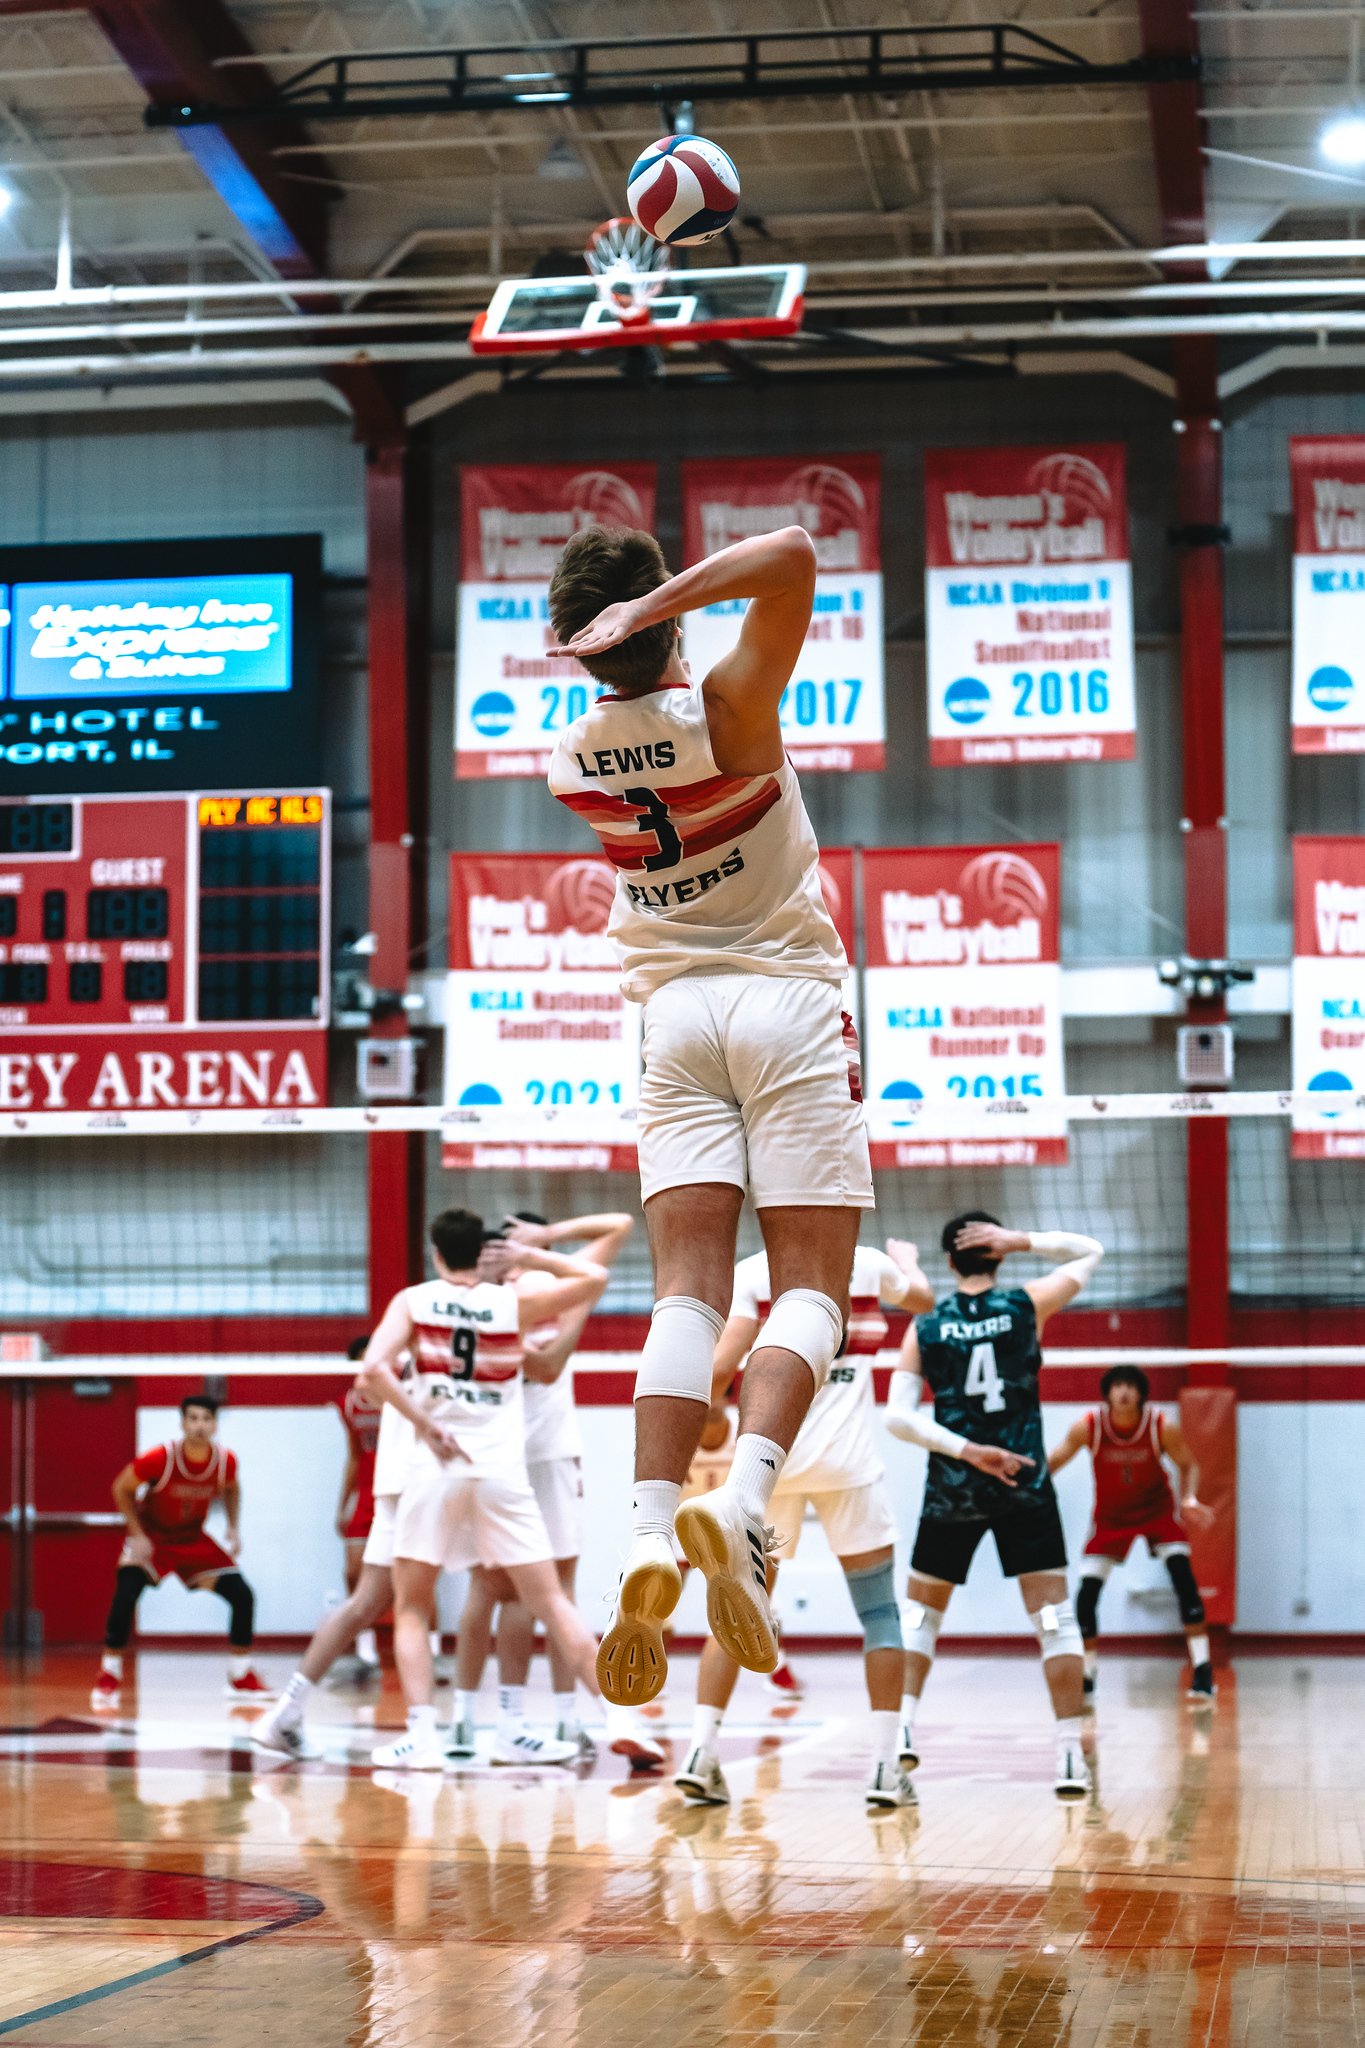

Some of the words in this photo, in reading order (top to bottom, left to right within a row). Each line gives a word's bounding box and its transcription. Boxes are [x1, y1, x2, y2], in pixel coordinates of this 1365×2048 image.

[30, 601, 200, 630] Holiday
[199, 599, 273, 623] Inn
[31, 622, 272, 662] Express
[540, 685, 606, 731] 20
[1012, 668, 1109, 717] 2016
[30, 706, 220, 735] HOTEL
[130, 738, 175, 760] IL
[575, 740, 676, 778] LEWIS
[624, 786, 684, 873] 3
[90, 856, 166, 886] GUEST
[626, 846, 746, 907] FLYERS
[471, 925, 622, 970] Volleyba
[882, 917, 1041, 967] Volleyball
[1322, 998, 1365, 1019] NCA
[0, 1052, 79, 1108] EY
[88, 1049, 319, 1107] ARENA
[939, 1314, 1013, 1342] FLYERS
[451, 1326, 476, 1381] 9
[963, 1341, 1007, 1414] 4
